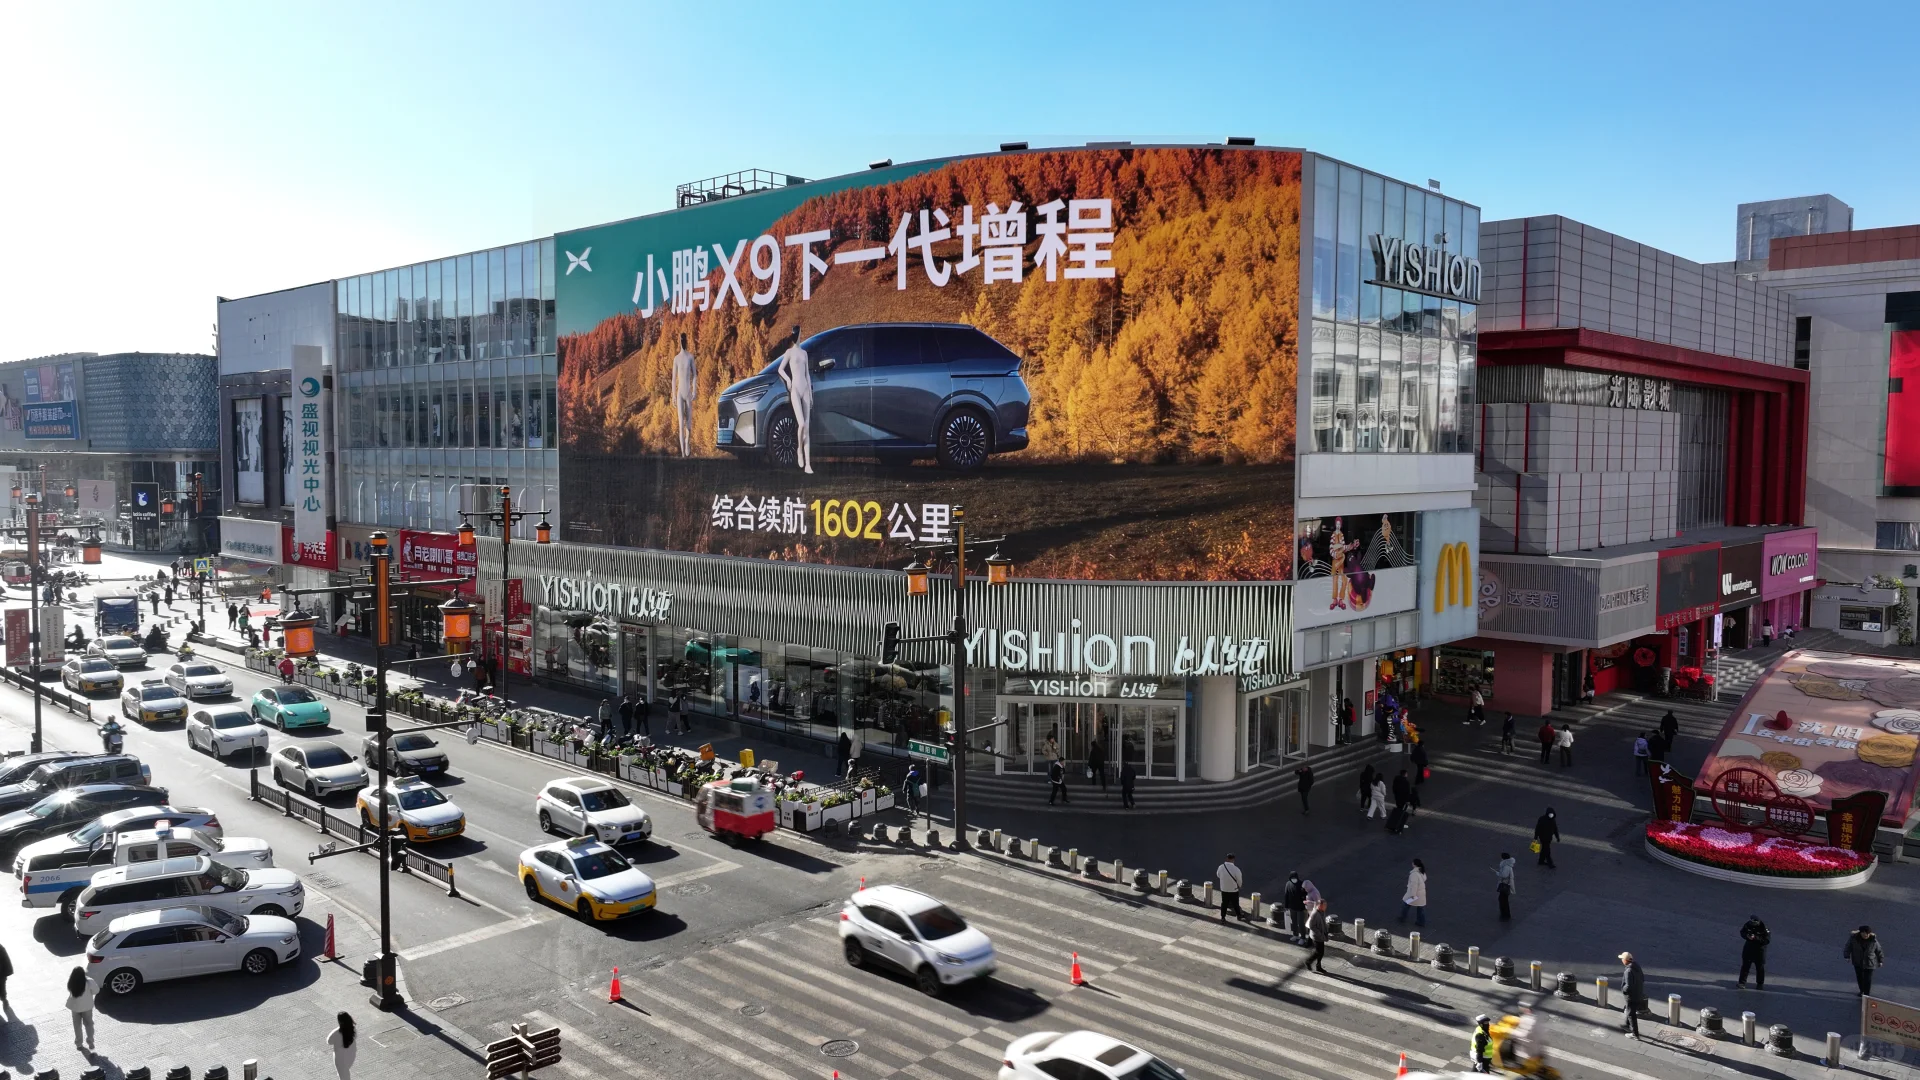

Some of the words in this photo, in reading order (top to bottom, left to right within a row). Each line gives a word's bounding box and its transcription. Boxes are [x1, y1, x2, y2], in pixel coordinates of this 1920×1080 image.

[631, 198, 1116, 319] 小鹏X9下一代增程
[1610, 375, 1670, 411] 光陆影城
[301, 403, 321, 512] 盛视视光中心
[711, 494, 950, 542] 综合续航1602公里
[1787, 553, 1809, 570] COLOUR
[1507, 590, 1560, 610] 达芙妮
[1755, 729, 1857, 749] 在中街等你
[1798, 721, 1863, 739] 沈阳
[1671, 785, 1681, 822] 魅力中街
[40, 874, 61, 883] 2066
